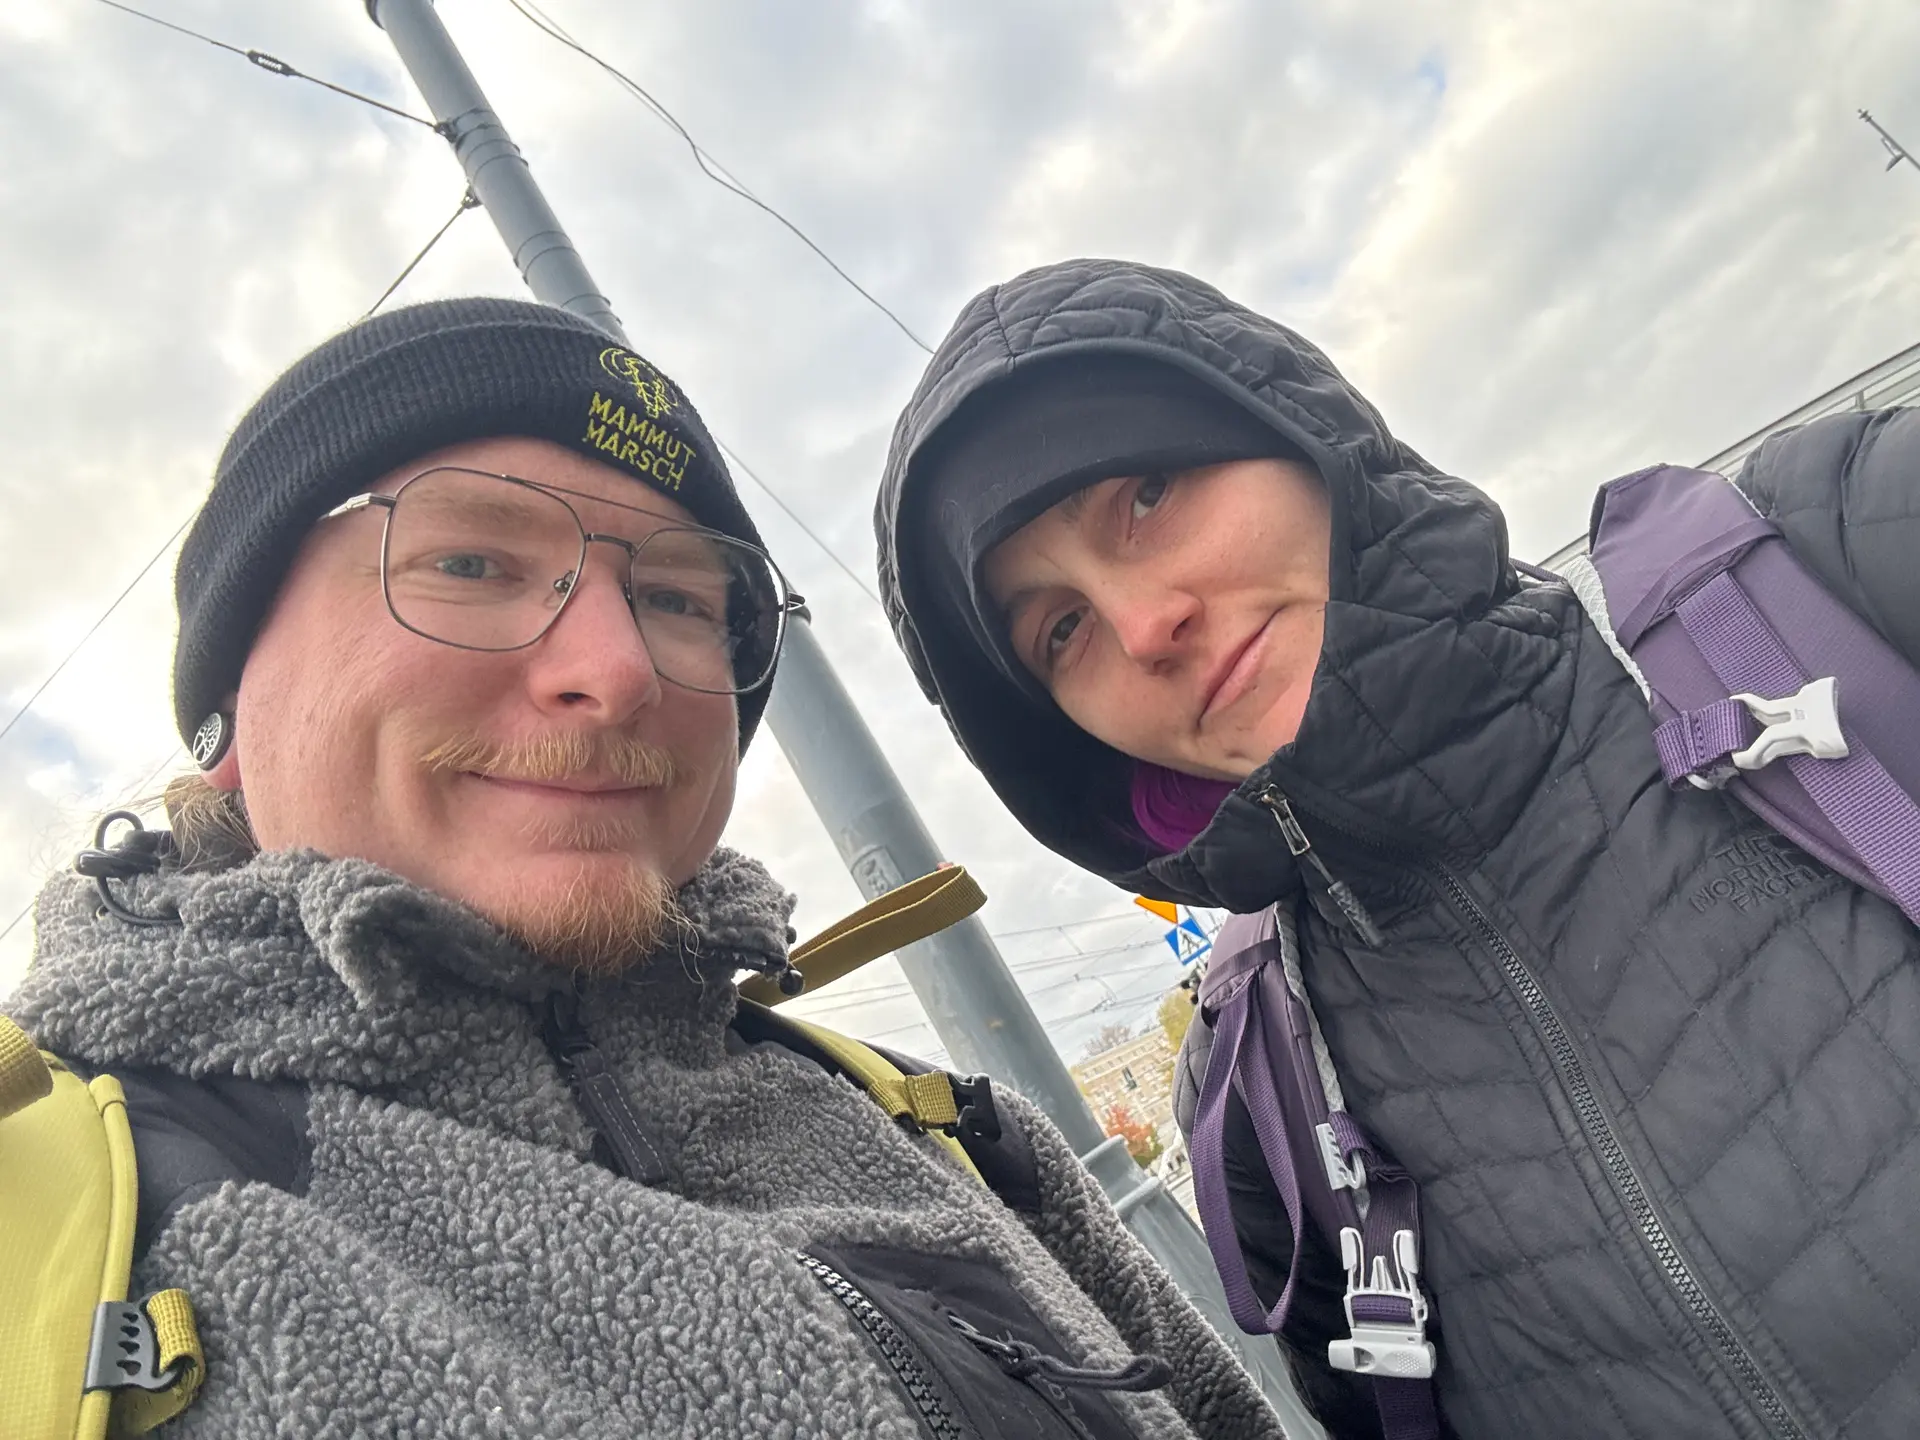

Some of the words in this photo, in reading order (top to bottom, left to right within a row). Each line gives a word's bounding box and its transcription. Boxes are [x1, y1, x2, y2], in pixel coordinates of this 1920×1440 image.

[586, 418, 685, 491] MARSCH
[589, 391, 697, 467] MAMMUT
[1688, 850, 1796, 913] NORTH
[1714, 836, 1773, 866] THE
[1731, 869, 1799, 914] FACE
